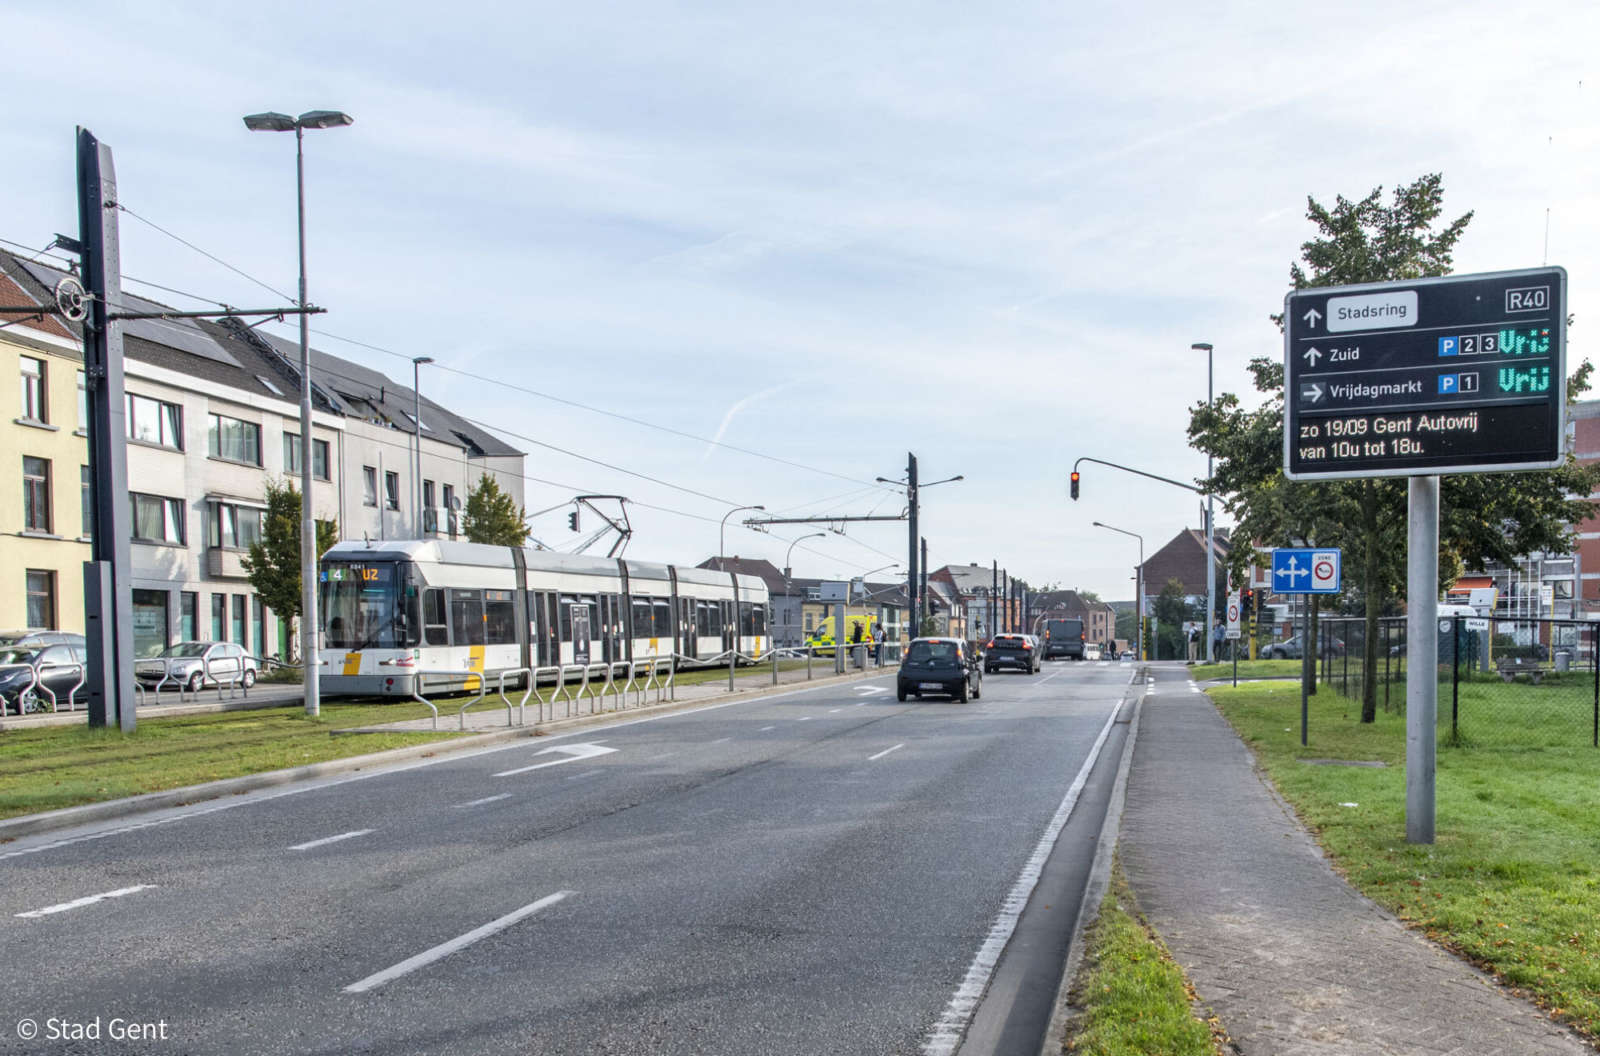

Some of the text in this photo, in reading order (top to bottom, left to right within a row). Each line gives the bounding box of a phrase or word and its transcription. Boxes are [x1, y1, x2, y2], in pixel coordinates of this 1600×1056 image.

[1510, 290, 1545, 309] R40
[1338, 304, 1407, 320] Stadsring
[1443, 337, 1495, 353] P 2 3
[1329, 347, 1360, 361] Zuid
[1443, 376, 1472, 391] P 1
[1498, 367, 1550, 392] Vrij
[1330, 380, 1423, 400] Vrijdagmarkt
[1300, 412, 1478, 438] zo 19/09 Gent Autovrij
[1299, 438, 1425, 460] van 10u tot 18u.
[334, 569, 343, 580] 4
